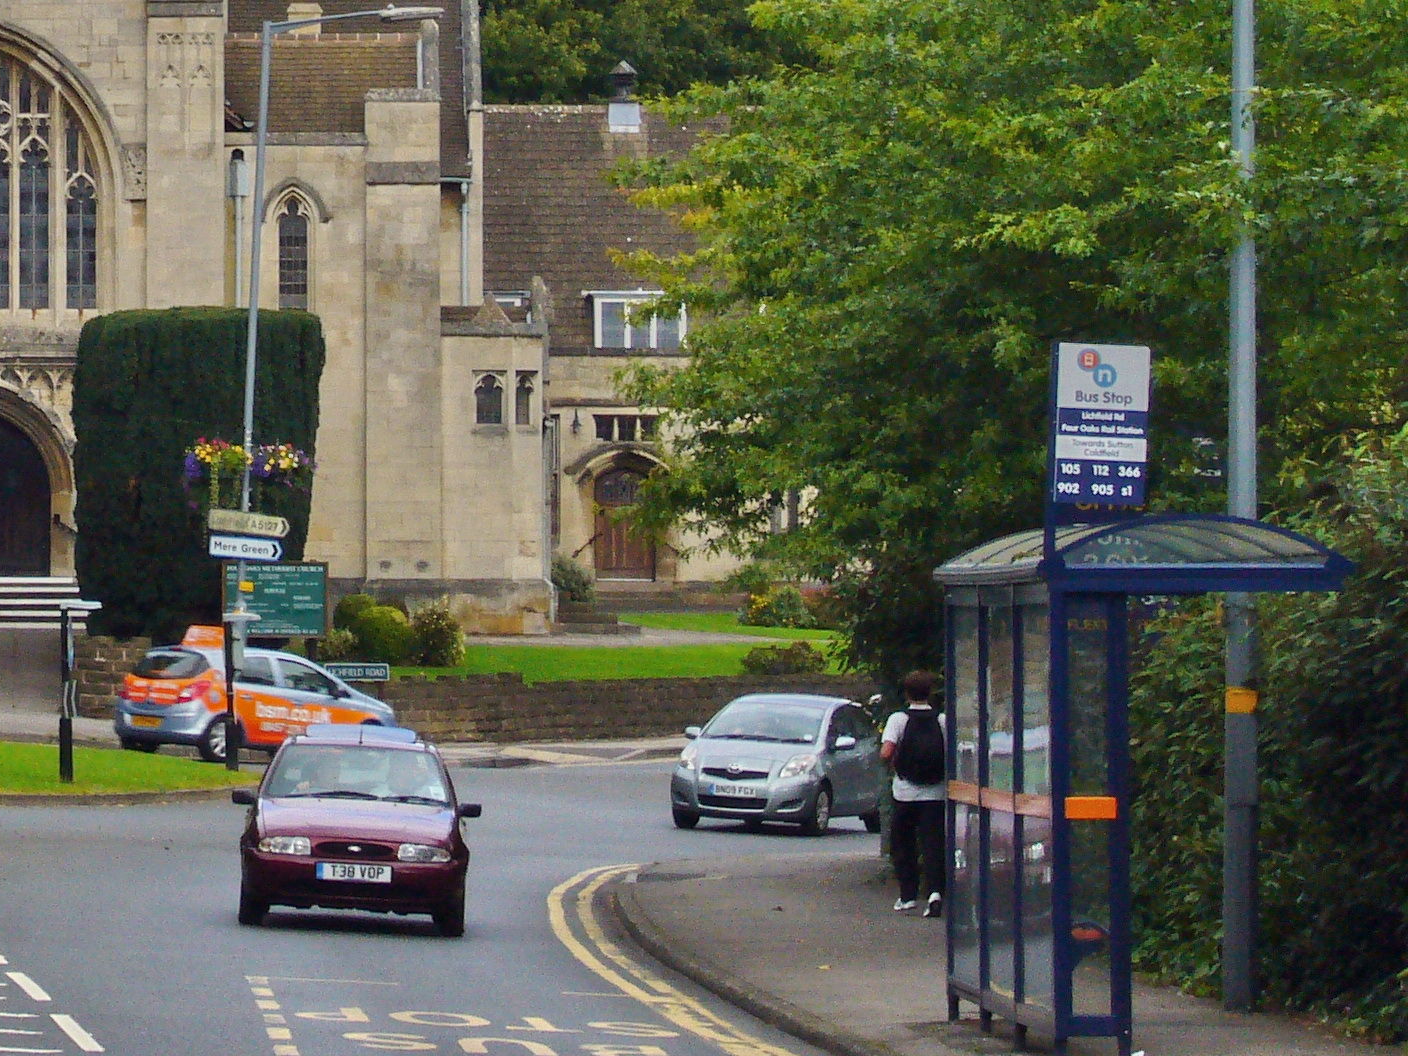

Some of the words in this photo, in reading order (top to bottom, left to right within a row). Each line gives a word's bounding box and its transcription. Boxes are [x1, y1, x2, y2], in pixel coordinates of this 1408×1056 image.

[1075, 391, 1099, 403] Bus
[1103, 391, 1133, 406] Stop
[1080, 424, 1100, 433] Oaks
[1116, 426, 1144, 435] Station
[1072, 438, 1105, 447] Towards
[1107, 440, 1134, 449] Sutton
[1060, 463, 1081, 475] 105
[1093, 465, 1110, 477] 112
[1118, 466, 1141, 478] 366
[1057, 482, 1080, 494] 902
[1091, 484, 1114, 496] 905
[214, 541, 237, 552] Mere
[241, 544, 269, 554] Green
[256, 701, 331, 723] bsm.co.uk
[331, 865, 355, 877] T38
